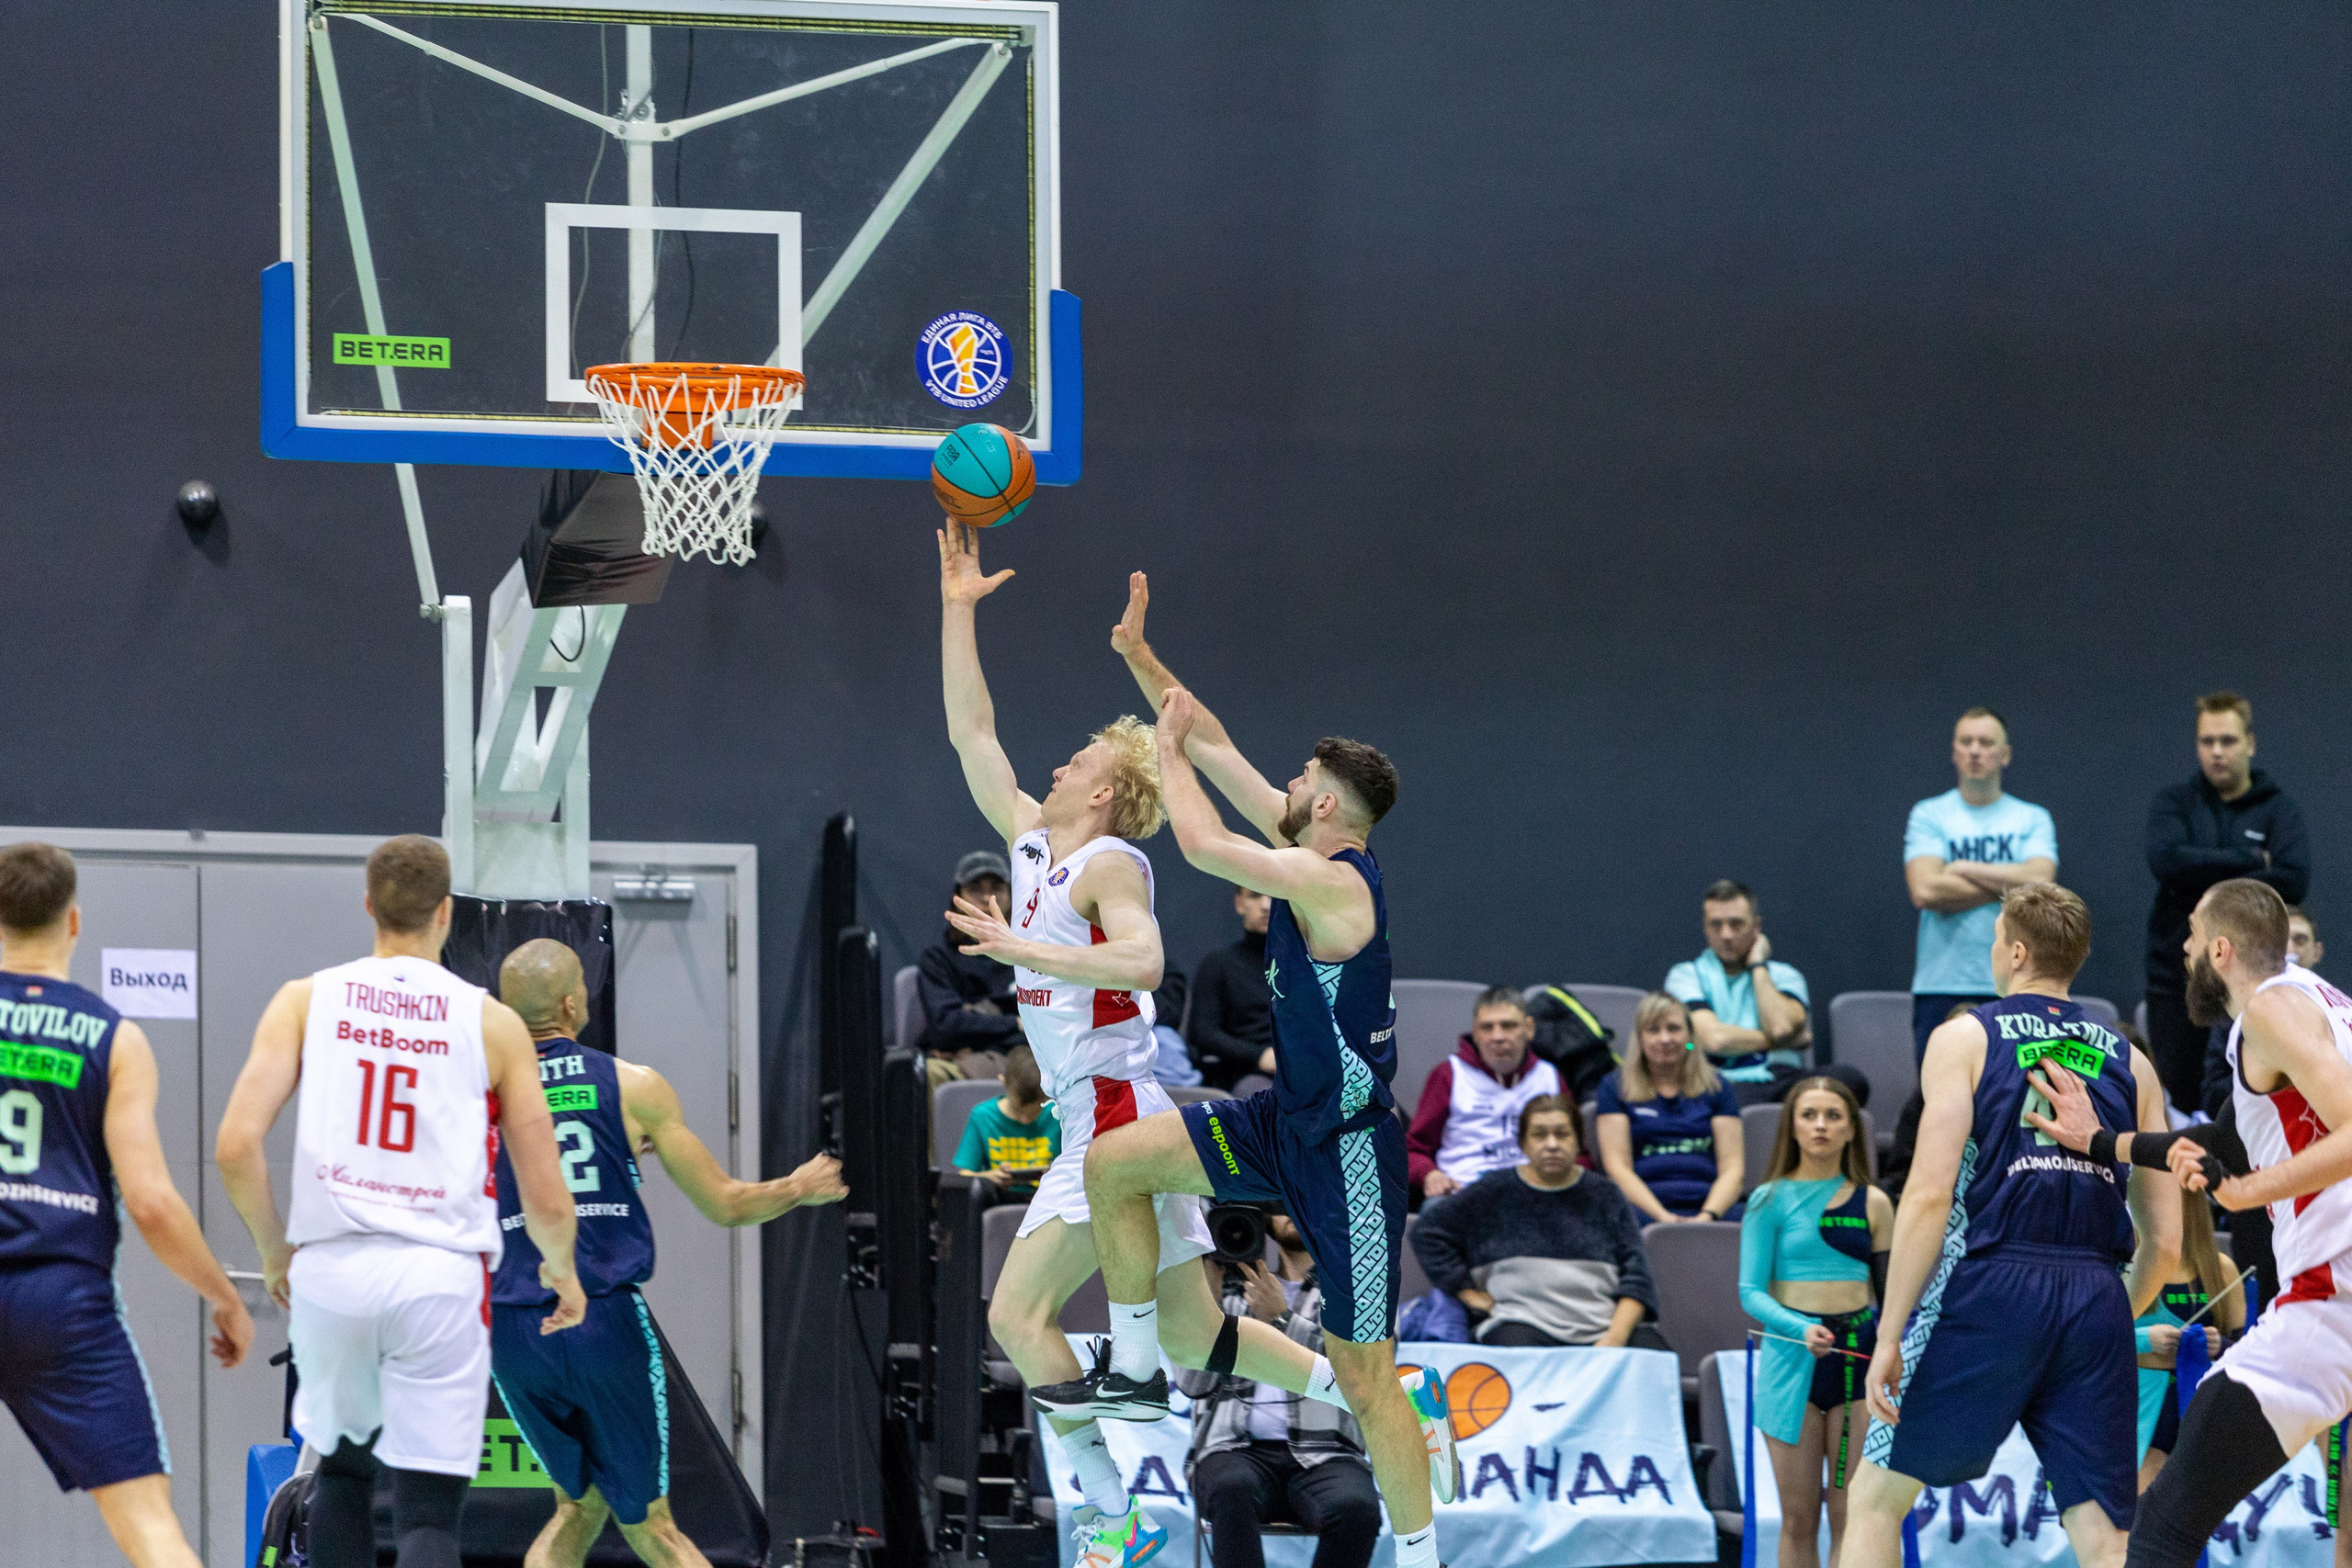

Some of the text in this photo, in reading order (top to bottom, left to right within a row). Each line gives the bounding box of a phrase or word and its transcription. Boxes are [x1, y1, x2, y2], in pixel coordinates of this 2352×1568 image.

[922, 312, 1003, 344] ЕДИНАЯ ЛИГА ВТБ
[341, 341, 443, 361] BET.ERA
[925, 376, 1009, 408] VTB UNITED LEAGUE
[1022, 887, 1040, 929] 9
[110, 967, 188, 991] Выход
[345, 982, 449, 1021] TRUSHKIN
[336, 1021, 449, 1055] BetBoom
[357, 1058, 419, 1154] 16
[1209, 1117, 1240, 1175] евроопт
[1459, 1446, 1674, 1506] АНДА
